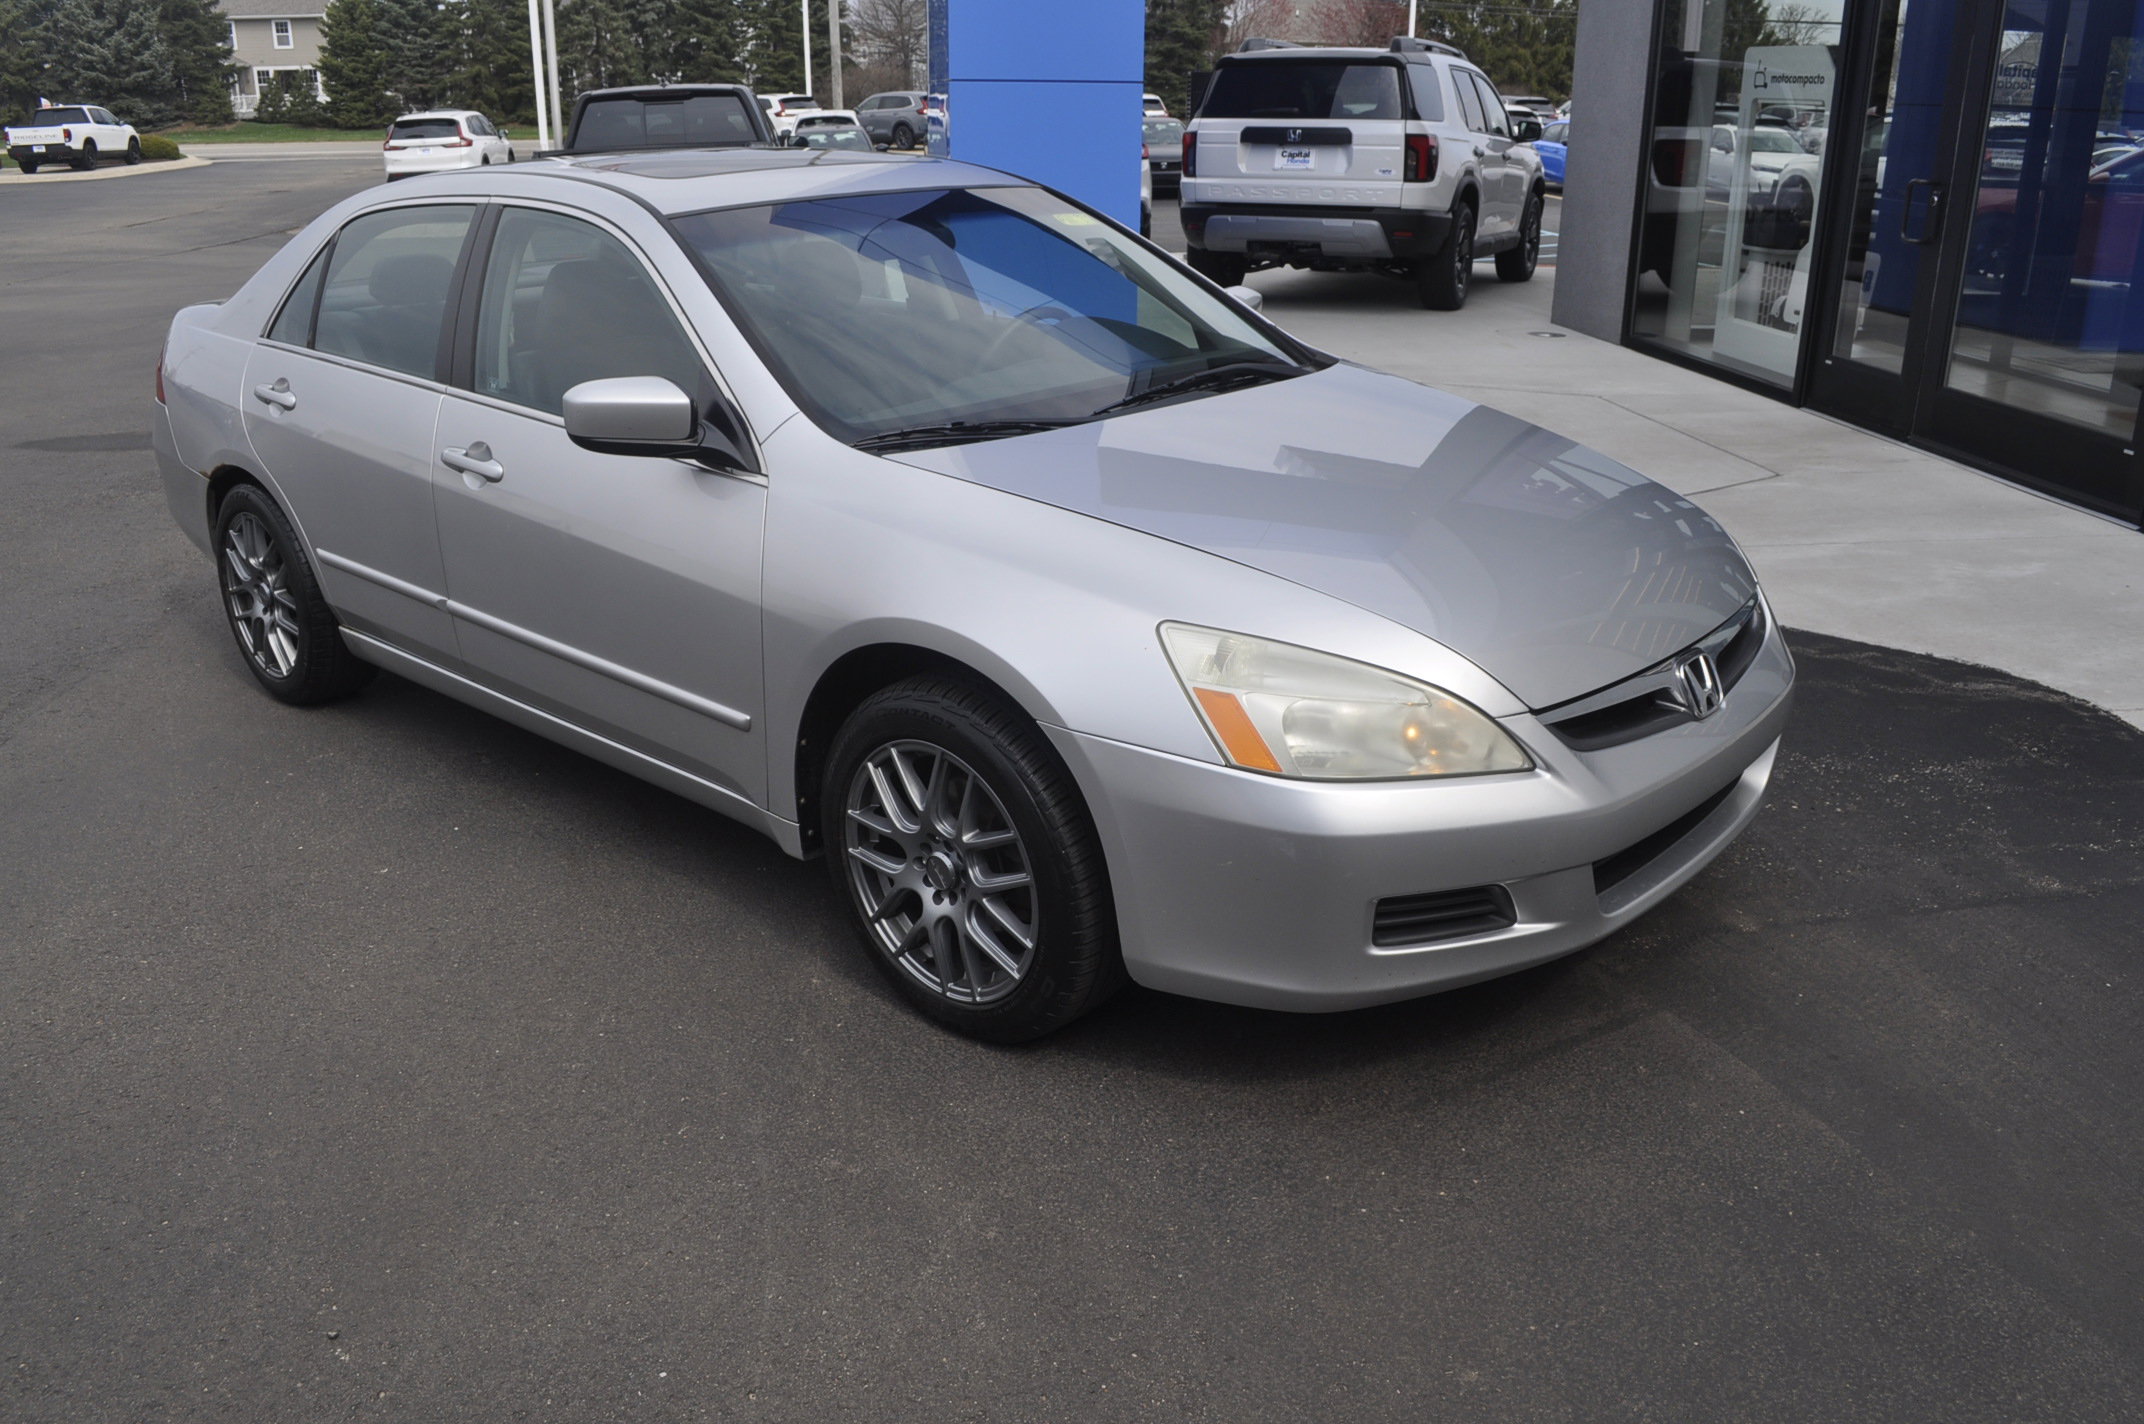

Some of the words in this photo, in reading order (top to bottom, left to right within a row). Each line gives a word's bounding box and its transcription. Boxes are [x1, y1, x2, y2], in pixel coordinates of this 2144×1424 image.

[1771, 73, 1825, 88] motocompacto
[1281, 150, 1311, 159] Capital
[1207, 184, 1385, 201] PASSPORT
